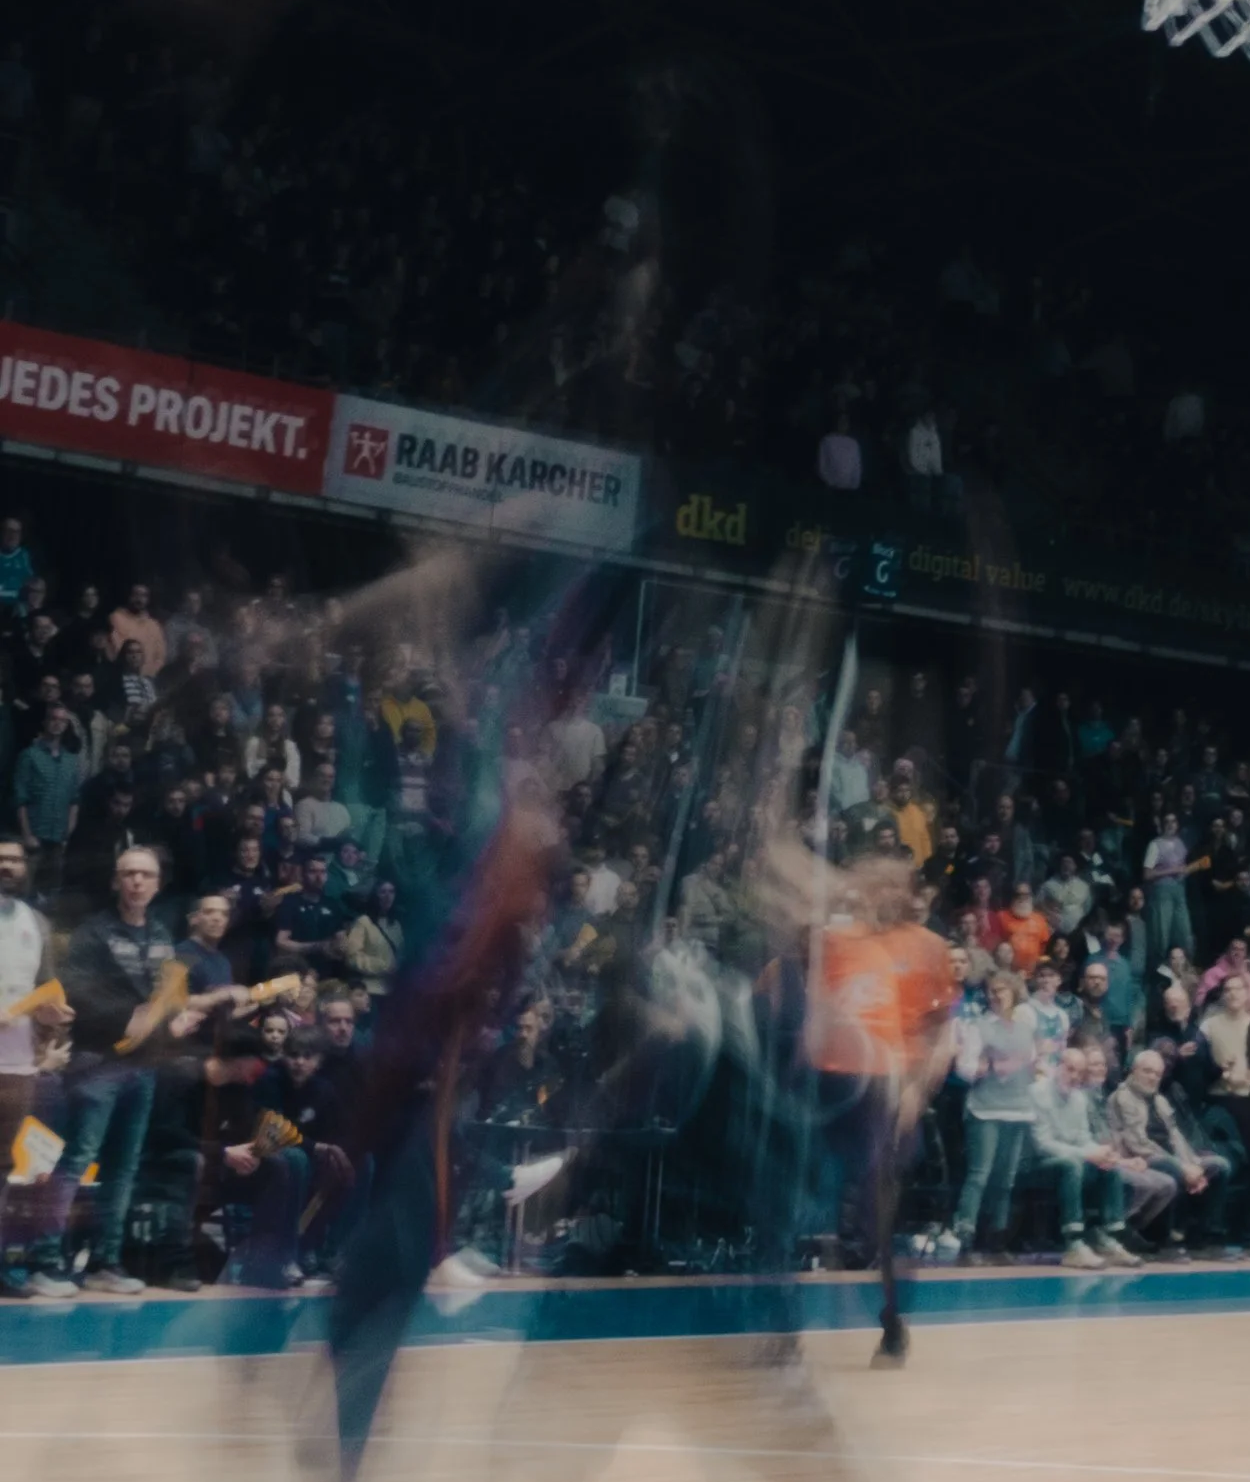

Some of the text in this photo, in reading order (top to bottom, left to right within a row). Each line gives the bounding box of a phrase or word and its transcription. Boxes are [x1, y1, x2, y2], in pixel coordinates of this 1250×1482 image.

[126, 383, 310, 460] PROJEKT.
[395, 432, 622, 508] RAAB KARCHER
[675, 492, 747, 546] dkd
[907, 543, 981, 584] digital
[984, 560, 1047, 594] value
